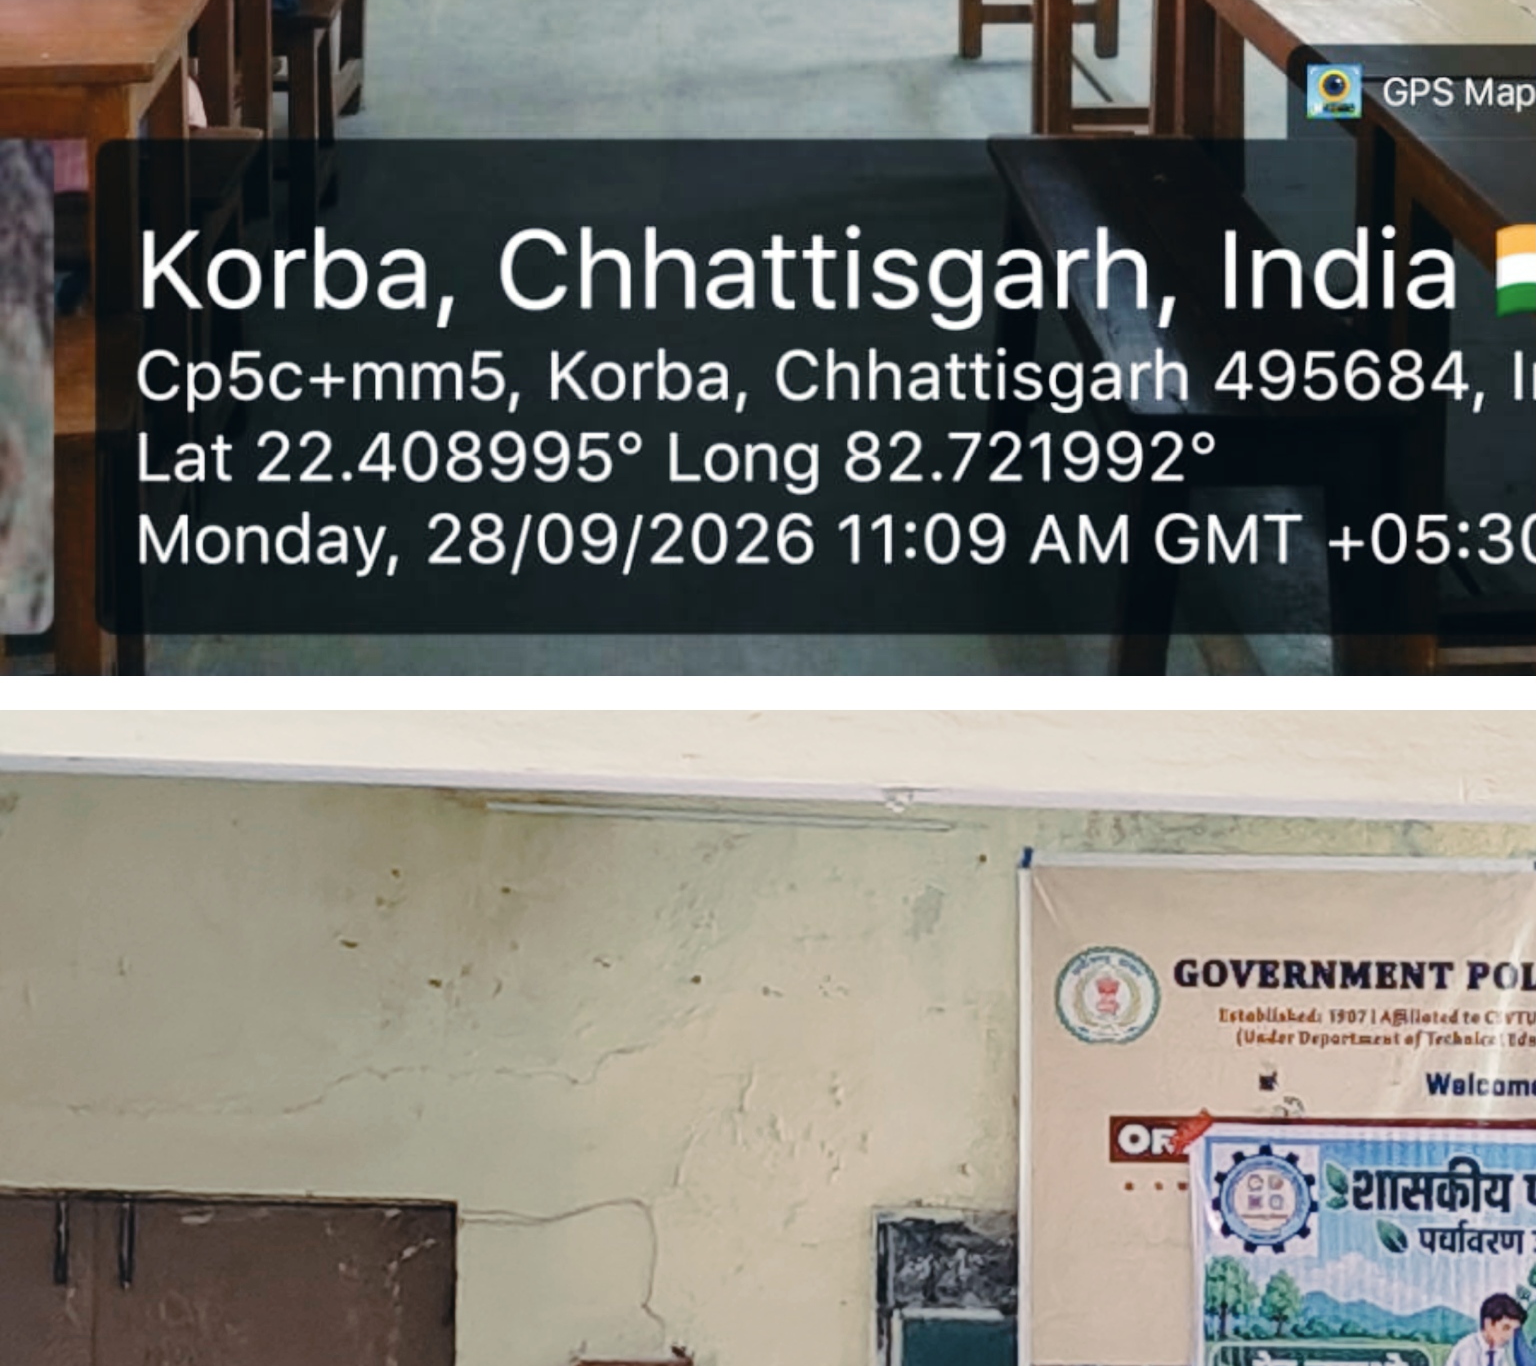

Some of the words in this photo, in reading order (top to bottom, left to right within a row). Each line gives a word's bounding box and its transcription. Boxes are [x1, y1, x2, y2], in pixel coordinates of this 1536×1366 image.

[1174, 958, 1455, 991] GOVERNMENT
[1351, 1156, 1514, 1214] शासकीय
[1418, 1220, 1525, 1255] पर्यावरण
